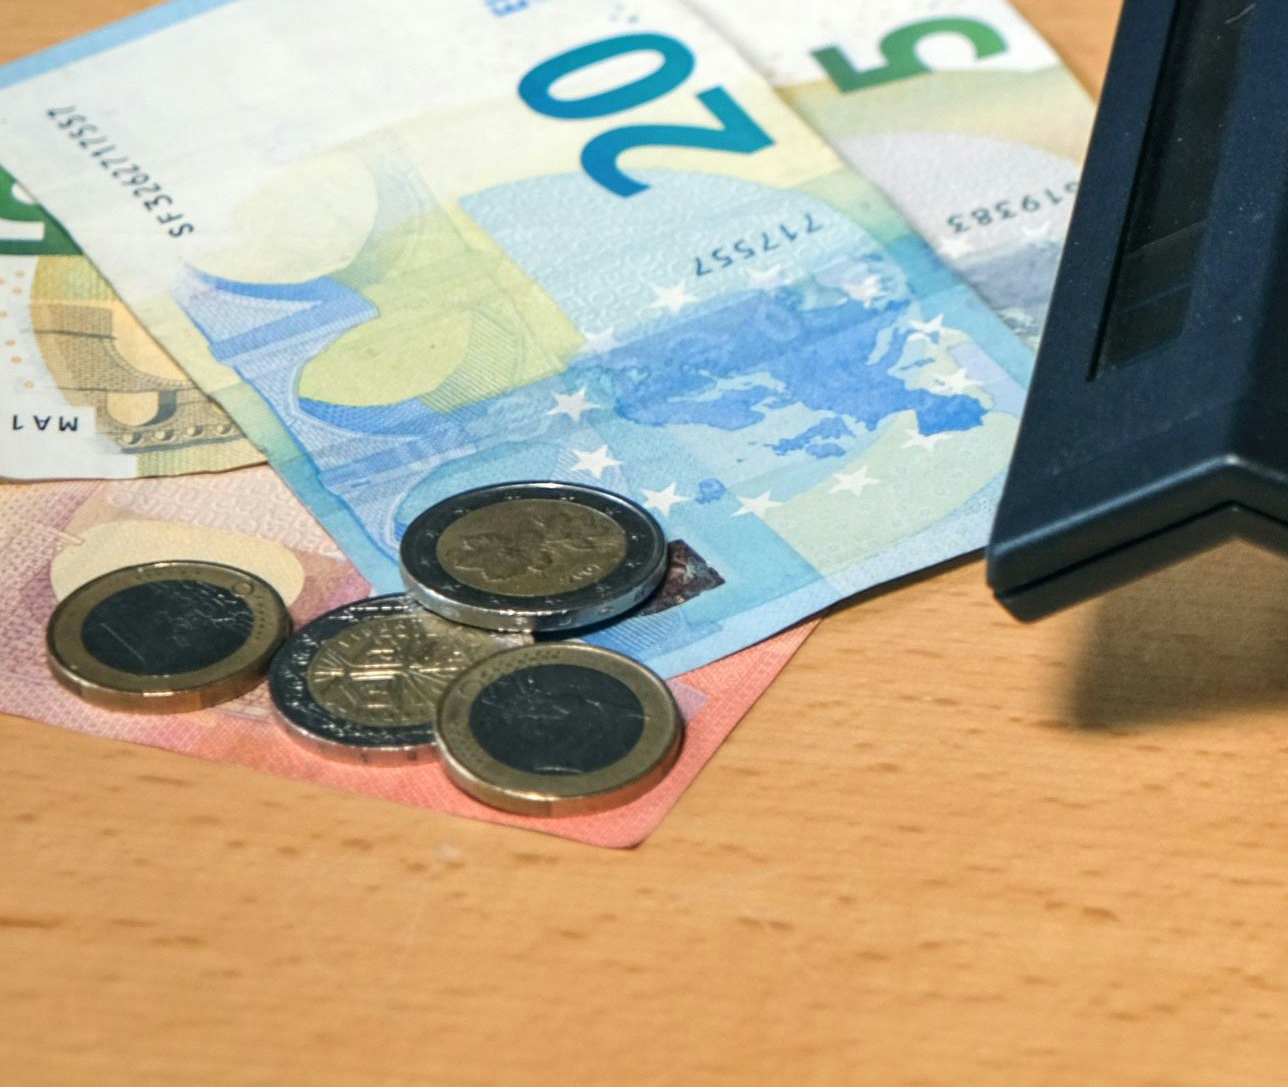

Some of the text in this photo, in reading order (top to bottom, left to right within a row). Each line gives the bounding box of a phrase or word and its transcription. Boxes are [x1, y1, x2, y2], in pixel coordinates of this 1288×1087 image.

[810, 15, 1009, 94] 5
[517, 32, 777, 199] 20
[694, 212, 824, 277] 717557
